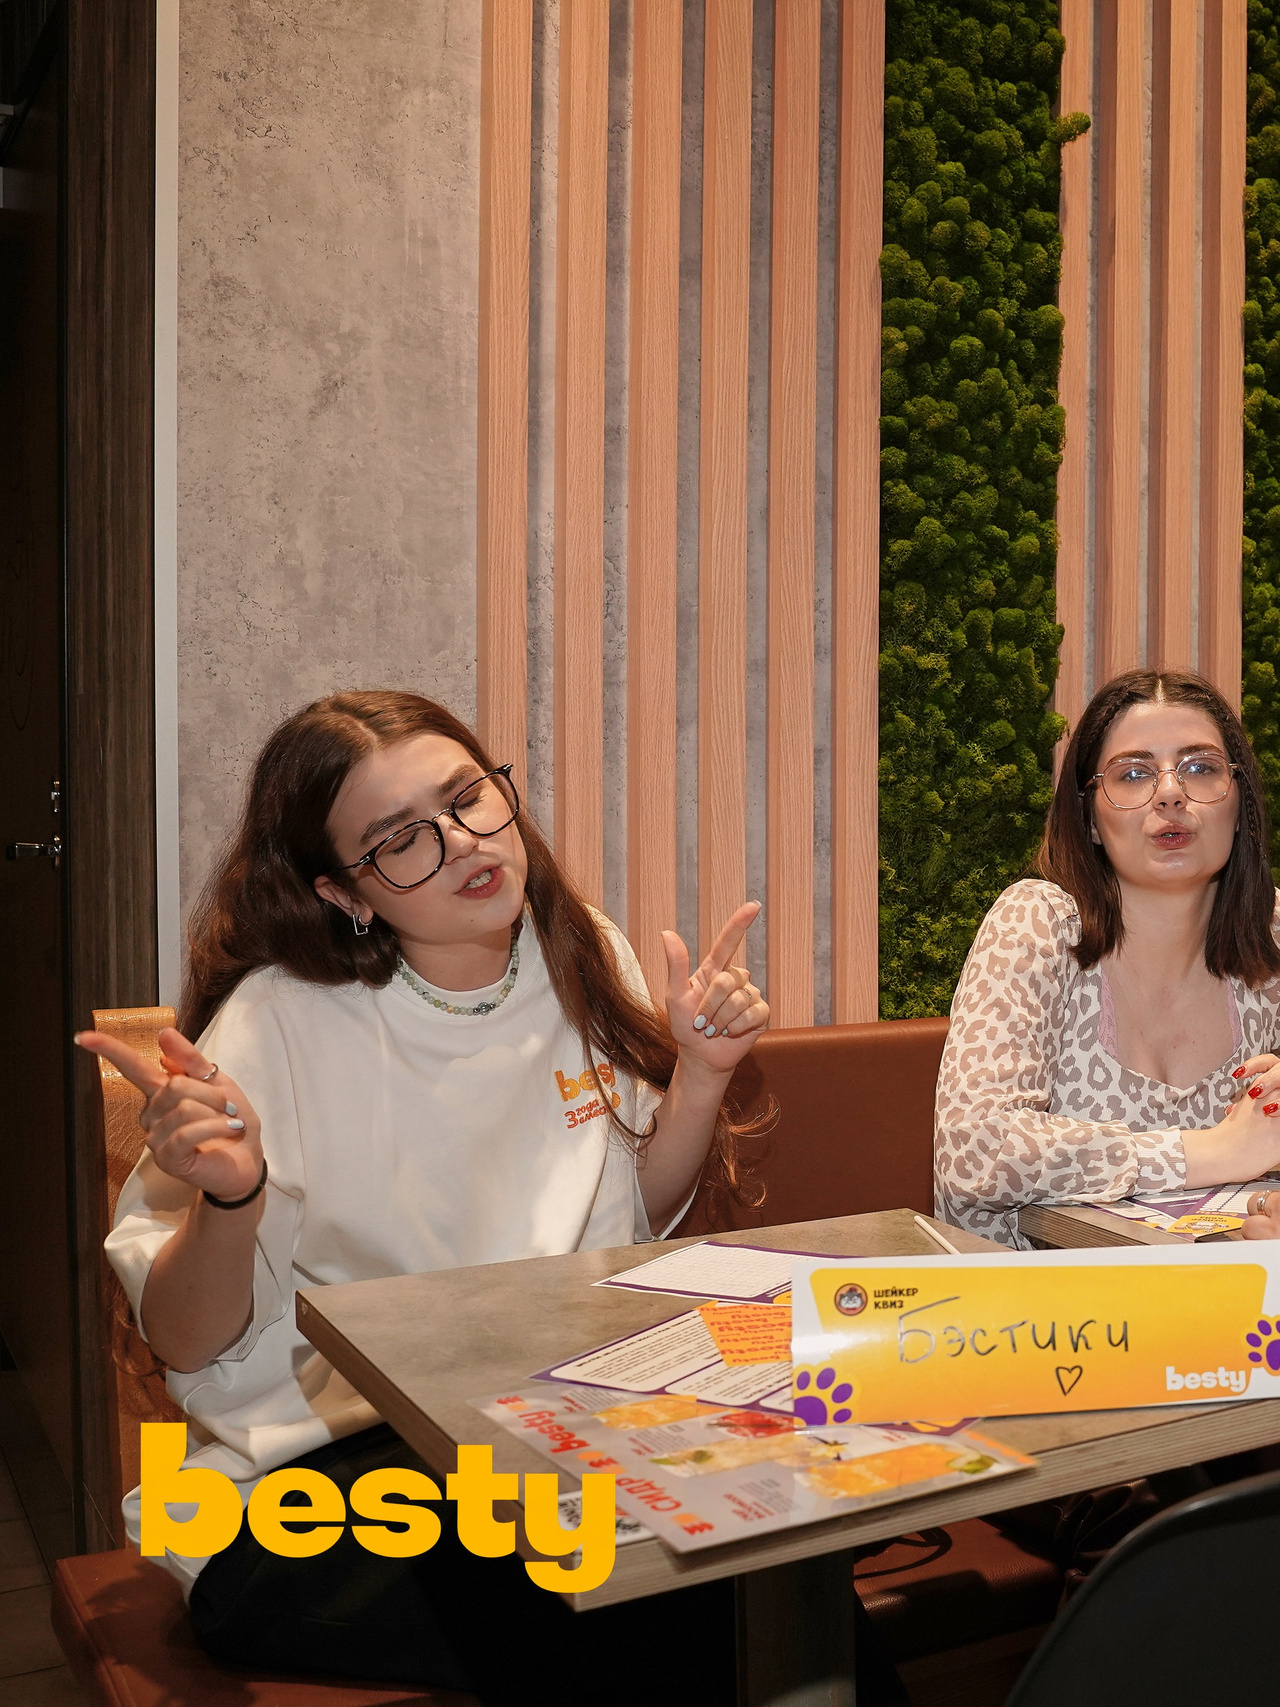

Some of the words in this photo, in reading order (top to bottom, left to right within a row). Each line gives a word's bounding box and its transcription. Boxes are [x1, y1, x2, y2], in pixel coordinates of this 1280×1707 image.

[564, 1110, 579, 1129] 3
[873, 1286, 919, 1298] ШЕЙКЕР
[874, 1300, 904, 1310] КВИЗ
[897, 1295, 1131, 1364] Бэстики
[1165, 1366, 1247, 1394] besty
[518, 1410, 591, 1454] besty
